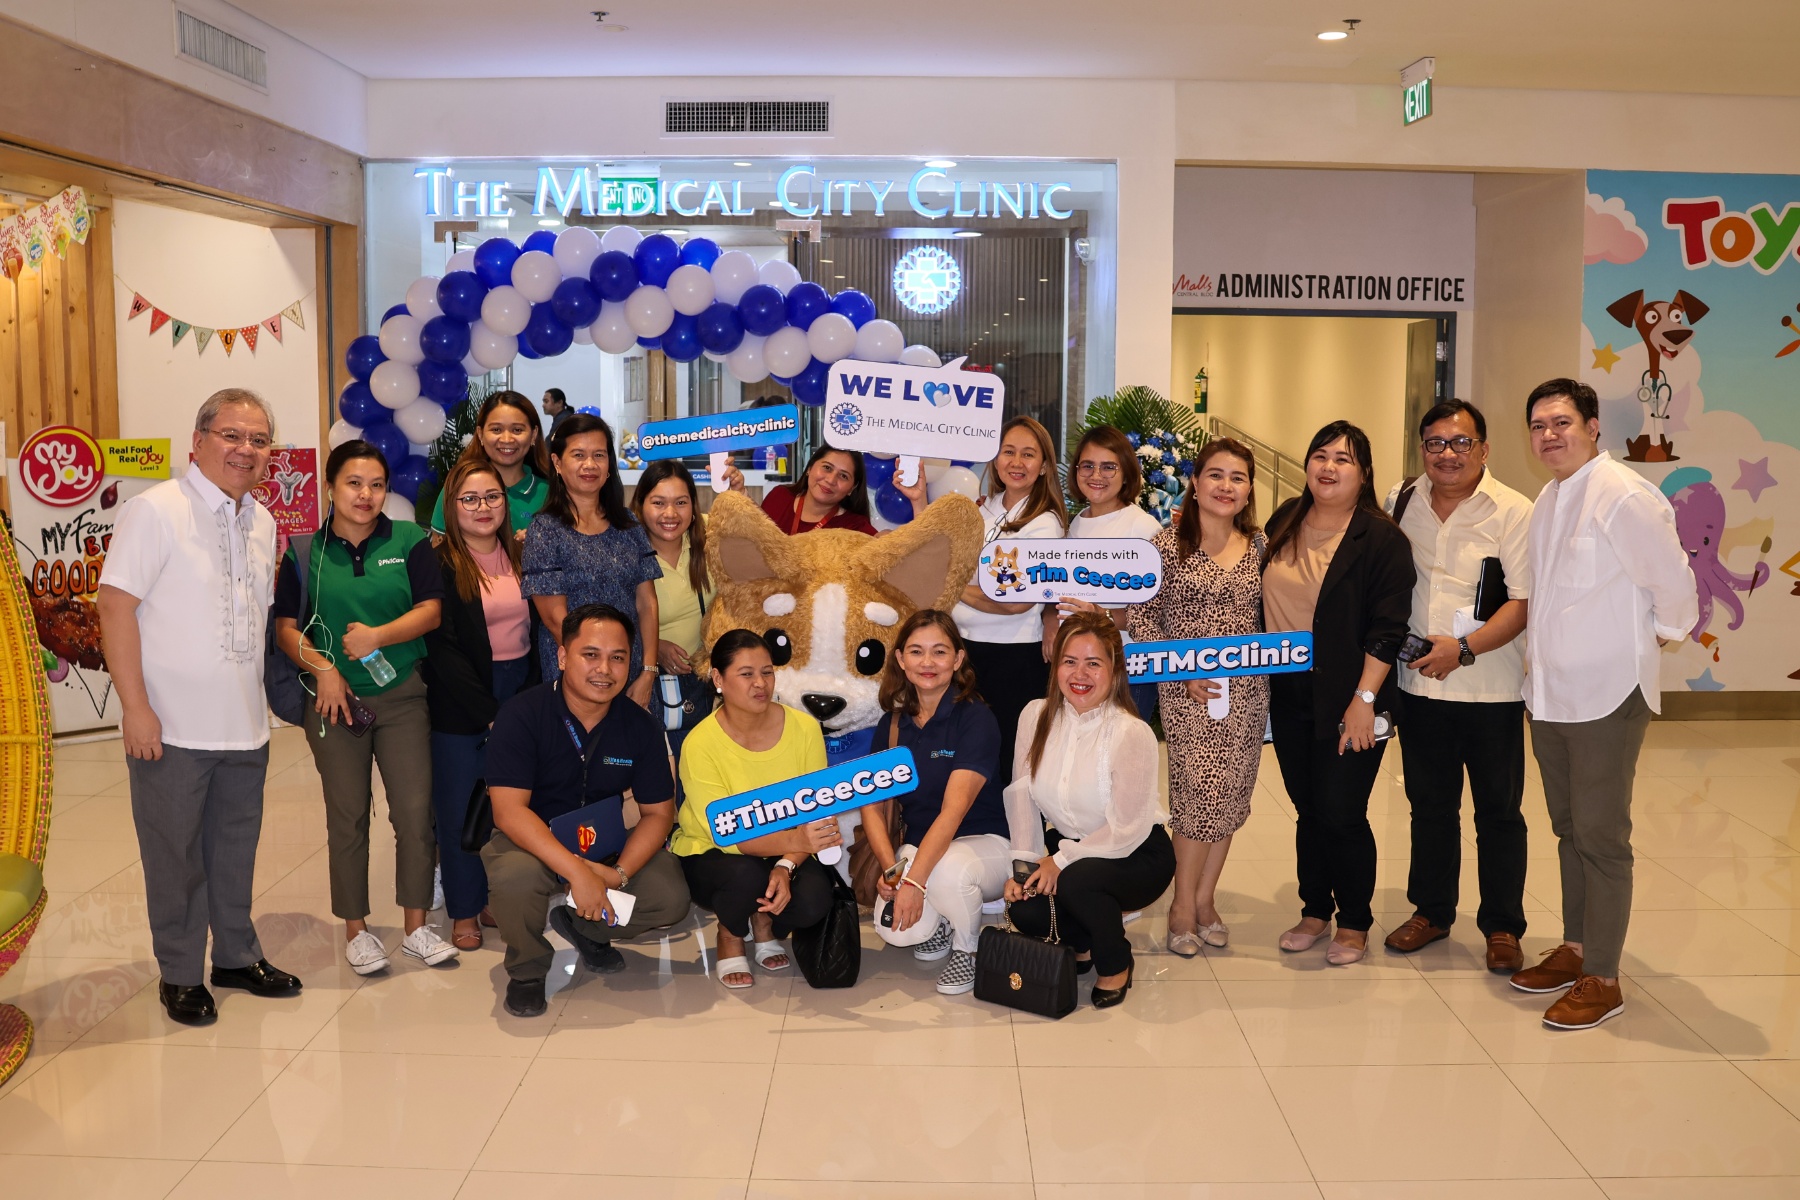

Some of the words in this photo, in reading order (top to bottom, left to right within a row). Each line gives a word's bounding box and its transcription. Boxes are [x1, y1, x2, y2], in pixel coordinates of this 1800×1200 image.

[1408, 79, 1428, 122] EXIT
[414, 167, 516, 217] THE
[531, 166, 755, 217] MEDICAL
[776, 165, 894, 218] CITY
[908, 167, 1073, 220] CLINIC
[1665, 199, 1800, 272] Toy
[1216, 273, 1391, 300] ADMINISTRATION
[1396, 276, 1465, 302] OFFICE
[840, 373, 893, 399] WE
[641, 416, 796, 450] @themedicalcityclinic
[866, 416, 886, 427] THE
[888, 418, 935, 433] MEDICAL
[937, 423, 962, 435] CITY
[963, 425, 997, 439] CLINIC
[34, 440, 77, 465] My
[109, 446, 128, 454] Real
[130, 445, 153, 454] Food
[119, 455, 138, 463] Real
[139, 450, 164, 466] Joy
[37, 458, 94, 495] Joy
[41, 522, 72, 555] MY
[70, 508, 114, 554] Fam
[275, 517, 304, 525] CKAGES
[1028, 550, 1061, 560] Made
[1065, 550, 1108, 560] friends
[1112, 550, 1139, 560] with
[1026, 562, 1068, 585] Tim
[1073, 566, 1157, 590] CeeCee
[1126, 639, 1310, 676] #TMCClinic
[714, 763, 913, 837] #TimCeeCee
